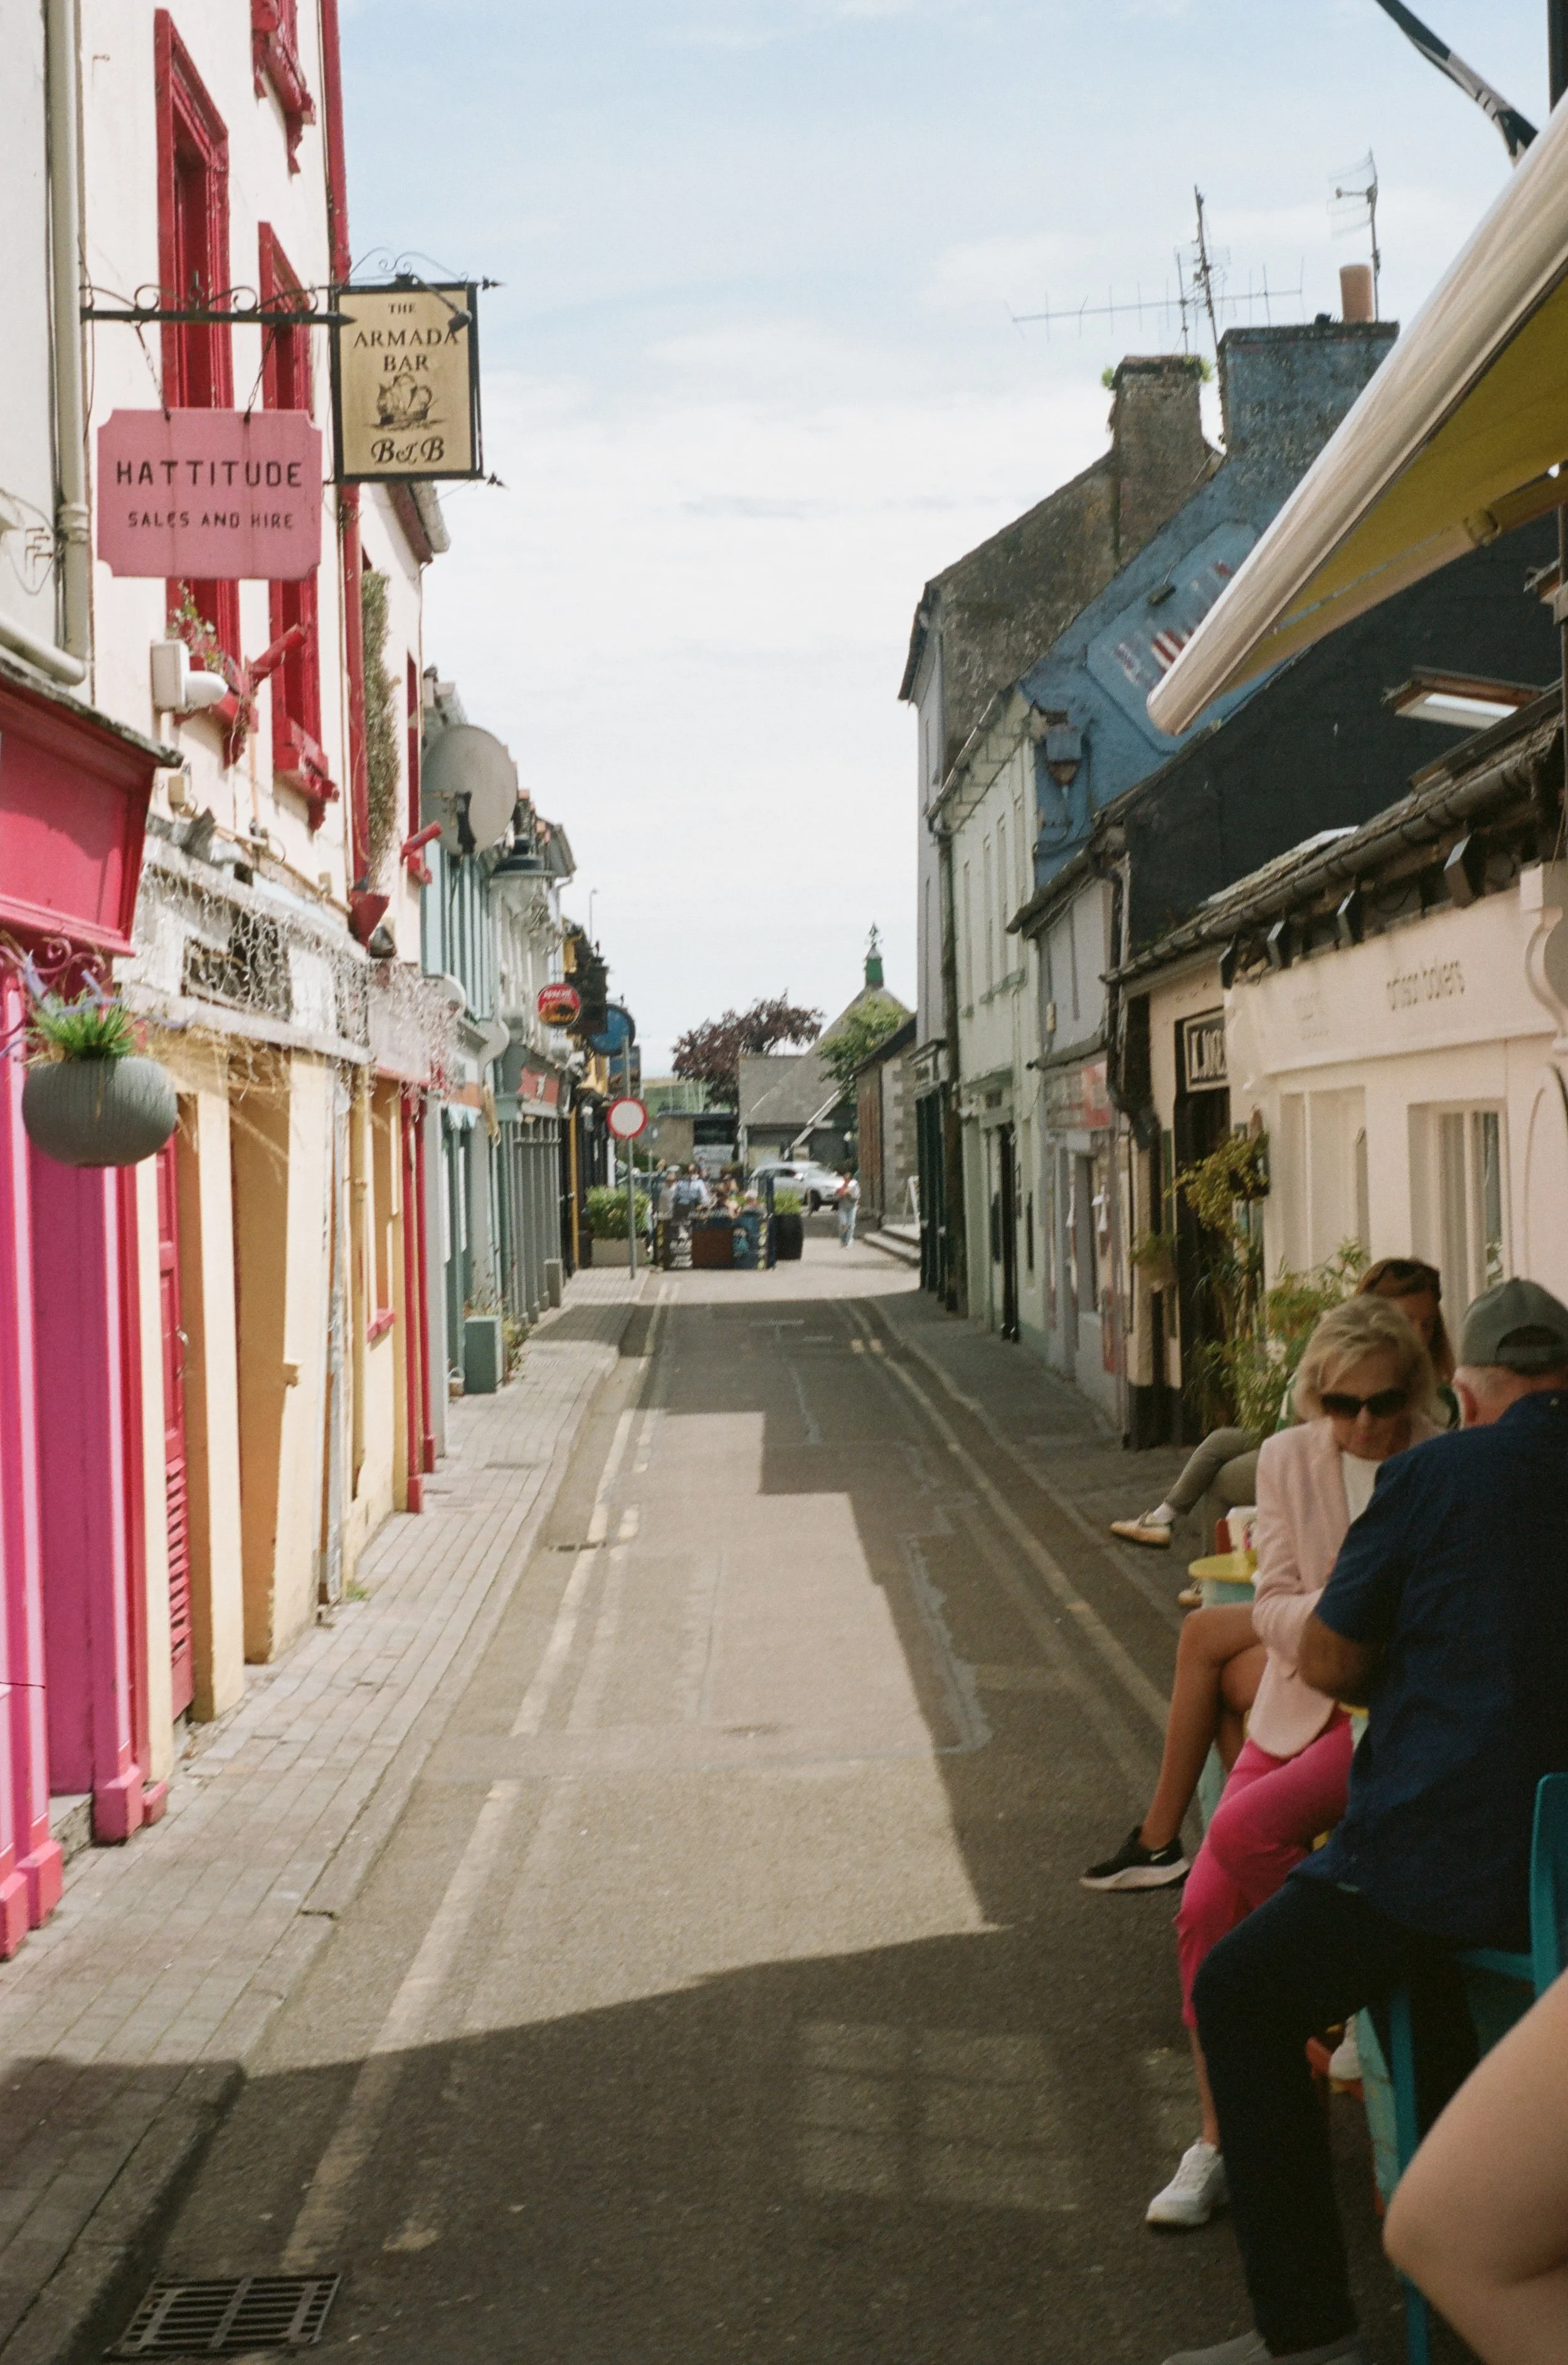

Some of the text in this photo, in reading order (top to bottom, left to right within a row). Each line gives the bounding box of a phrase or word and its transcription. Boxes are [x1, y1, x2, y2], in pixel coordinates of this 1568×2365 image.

[388, 302, 416, 315] THE
[354, 327, 460, 348] ARMADA
[383, 354, 430, 373] BAR
[116, 460, 302, 487] HATTITUDE
[128, 511, 294, 531] SALES AND HIRE
